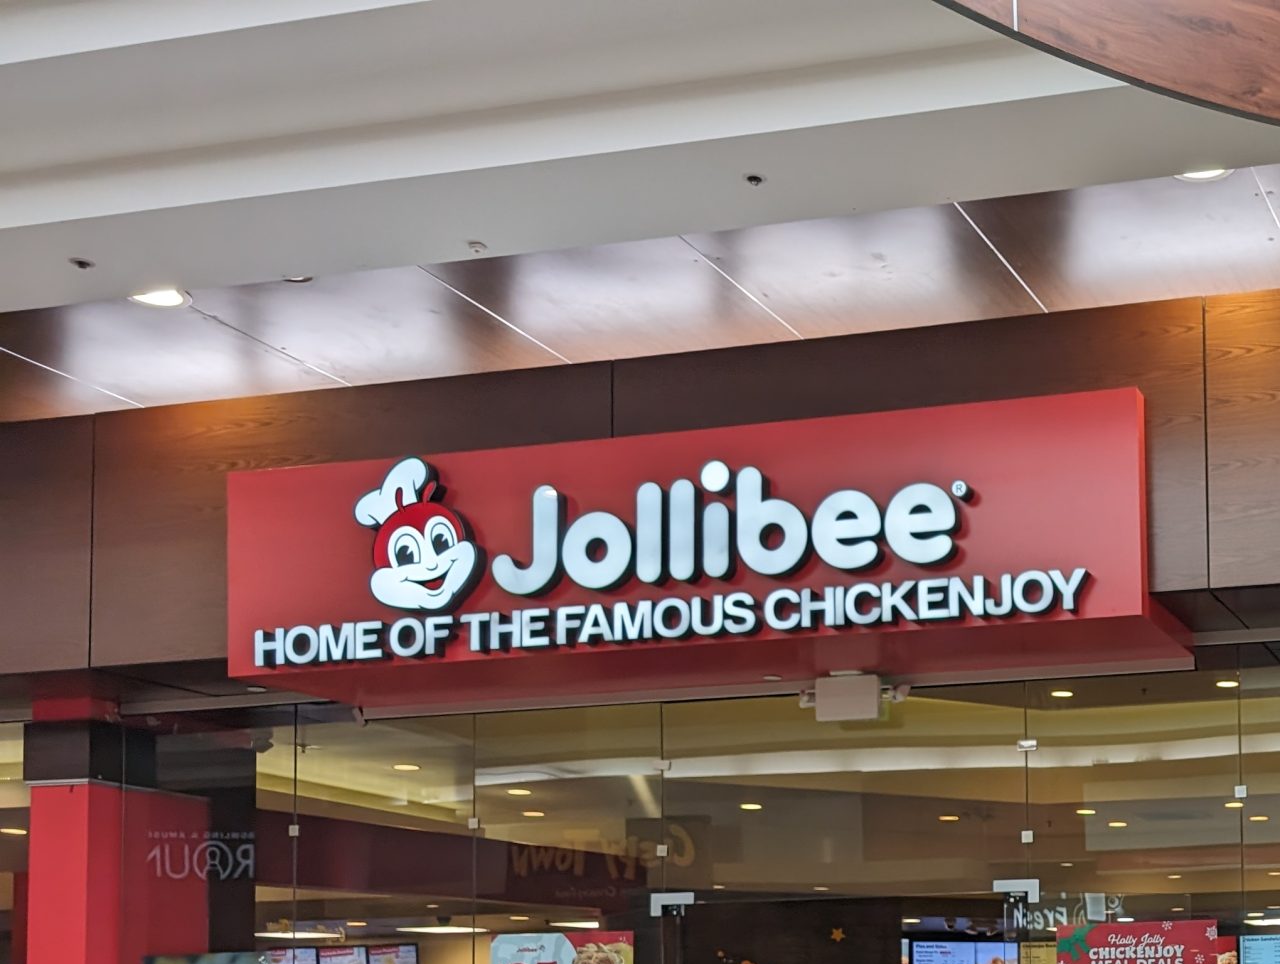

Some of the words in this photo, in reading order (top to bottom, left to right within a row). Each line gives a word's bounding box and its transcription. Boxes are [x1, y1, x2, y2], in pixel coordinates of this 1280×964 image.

[254, 620, 384, 668] HOME
[389, 615, 454, 658] OF
[460, 606, 551, 652] THE
[555, 590, 757, 646] FAMOUS
[763, 567, 1088, 631] CHICKENJOY
[1107, 933, 1138, 947] Holly
[1139, 932, 1166, 950] Jolly
[1088, 944, 1185, 960] CHICKENJOY
